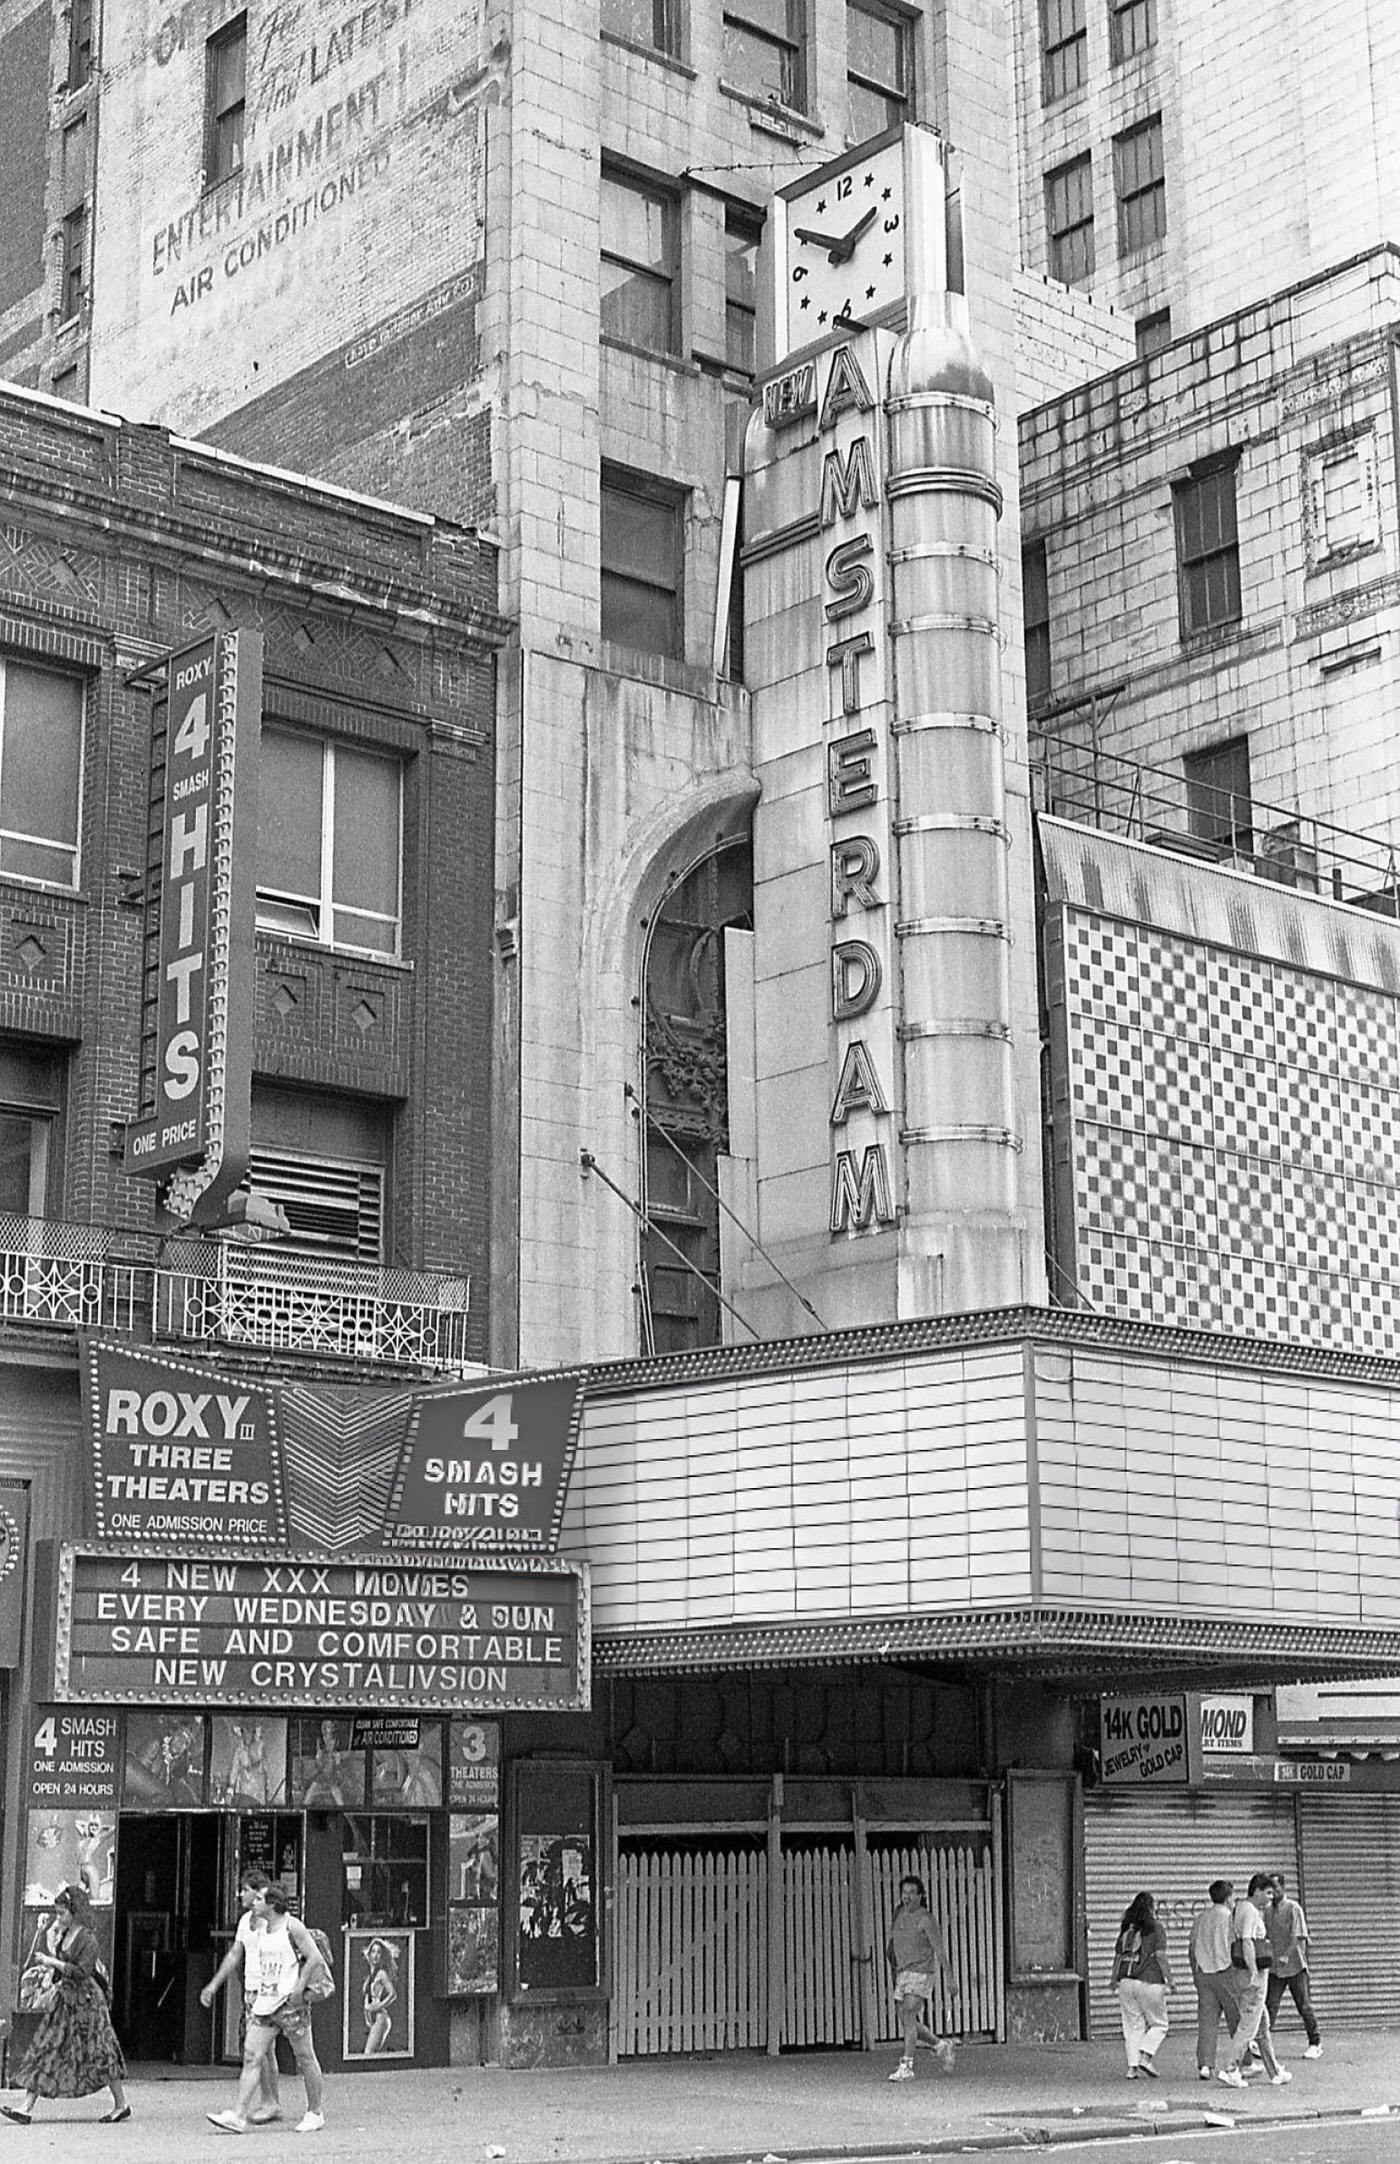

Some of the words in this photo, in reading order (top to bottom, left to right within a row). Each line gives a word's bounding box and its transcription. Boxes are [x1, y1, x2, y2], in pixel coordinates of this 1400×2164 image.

[836, 176, 853, 201] 12
[171, 266, 213, 316] AIR
[224, 150, 390, 278] CONDITIONED
[884, 214, 899, 233] 3
[765, 364, 814, 426] NEW
[176, 656, 212, 691] ROXY
[174, 692, 210, 760] 4
[173, 768, 209, 801] SMASH
[818, 345, 895, 1233] AMSTERDAM
[164, 802, 208, 1101] HITS
[133, 1132, 157, 1156] ONE
[162, 1118, 197, 1148] PRICE
[106, 1389, 250, 1440] ROXY
[463, 1394, 519, 1451] 4
[129, 1443, 233, 1471] THREE
[424, 1458, 543, 1488] SMASH
[106, 1474, 269, 1505] THEATERS
[444, 1492, 519, 1519] HITS
[111, 1513, 141, 1528] ONE
[146, 1515, 223, 1531] ADMISSION
[228, 1518, 268, 1533] PRICE
[121, 1561, 142, 1588] 4
[166, 1563, 238, 1591] NEW
[263, 1567, 331, 1593] XXX
[355, 1570, 469, 1598] MOVIES
[98, 1593, 209, 1621] EVERY
[233, 1597, 436, 1628] WEDNESDAY
[460, 1604, 479, 1629] &
[111, 1626, 200, 1653] SAFE
[224, 1629, 293, 1655] AND
[318, 1631, 562, 1662] COMFORTABLE
[154, 1658, 227, 1686] NEW
[250, 1661, 507, 1691] CRYSTALIVSION
[34, 1717, 57, 1756] 4
[61, 1717, 116, 1736] SMASH
[1104, 1707, 1134, 1739] 14K
[1137, 1705, 1182, 1740] GOLD
[1202, 1709, 1247, 1738] MOND
[70, 1739, 104, 1757] HITS
[462, 1725, 486, 1762] 3
[1104, 1742, 1143, 1777] JEWELRY
[1140, 1754, 1164, 1777] GOLD
[1164, 1744, 1182, 1766] CAP
[34, 1760, 55, 1772] ONE
[59, 1761, 114, 1773] ADMISSION
[450, 1766, 498, 1779] THEATERS
[1300, 1764, 1325, 1779] GOLD
[1327, 1764, 1346, 1779] CAP
[33, 1782, 60, 1794] OPEN
[64, 1782, 77, 1794] 24
[80, 1783, 113, 1795] HOURS
